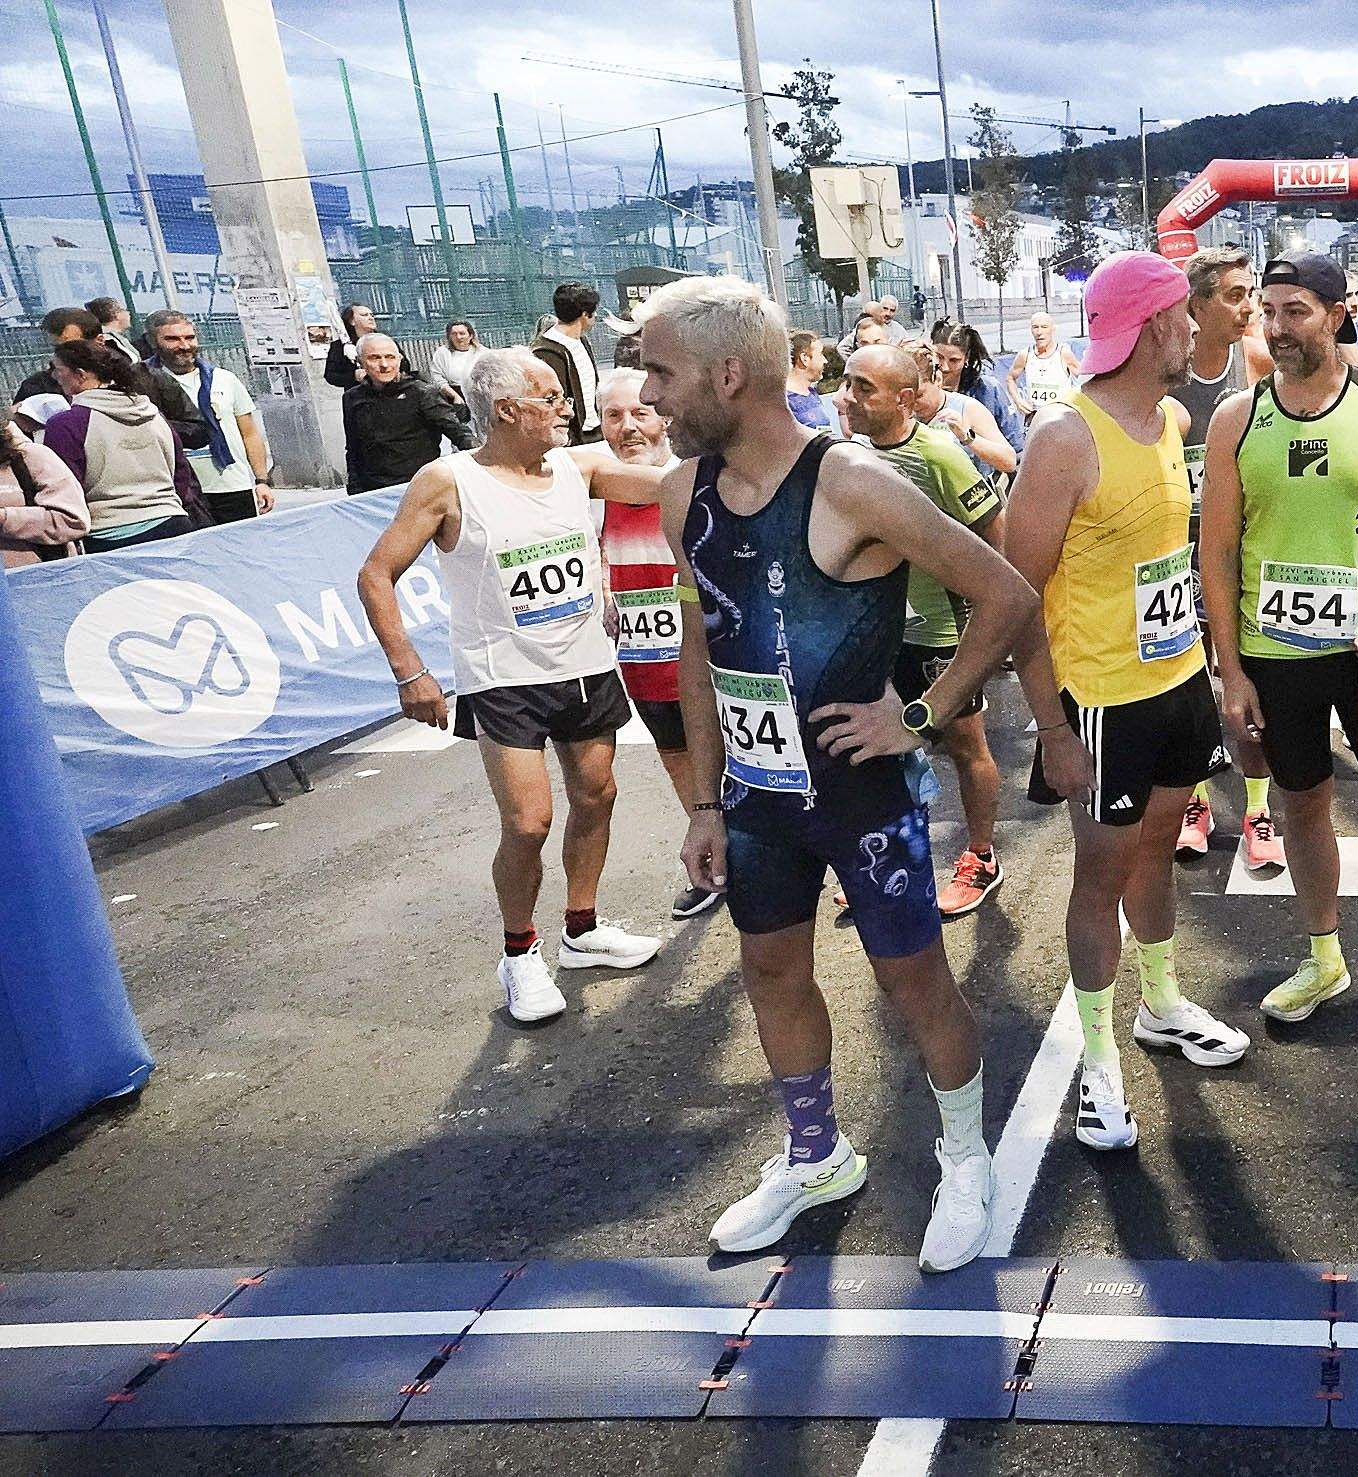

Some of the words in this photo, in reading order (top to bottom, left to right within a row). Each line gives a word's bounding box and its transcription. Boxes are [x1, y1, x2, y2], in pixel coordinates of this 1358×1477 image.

[1278, 164, 1345, 186] FROIZ
[1177, 182, 1217, 218] FROIZ
[130, 270, 237, 294] MAERS
[510, 557, 584, 600] 409
[1307, 576, 1349, 584] MIGUEL
[1143, 576, 1193, 627] 427
[1262, 589, 1348, 627] 454
[621, 610, 677, 640] 448
[1139, 632, 1158, 641] FROIZ
[736, 687, 778, 699] MIGUL
[722, 702, 787, 755] 434
[1083, 1281, 1145, 1299] Feibot
